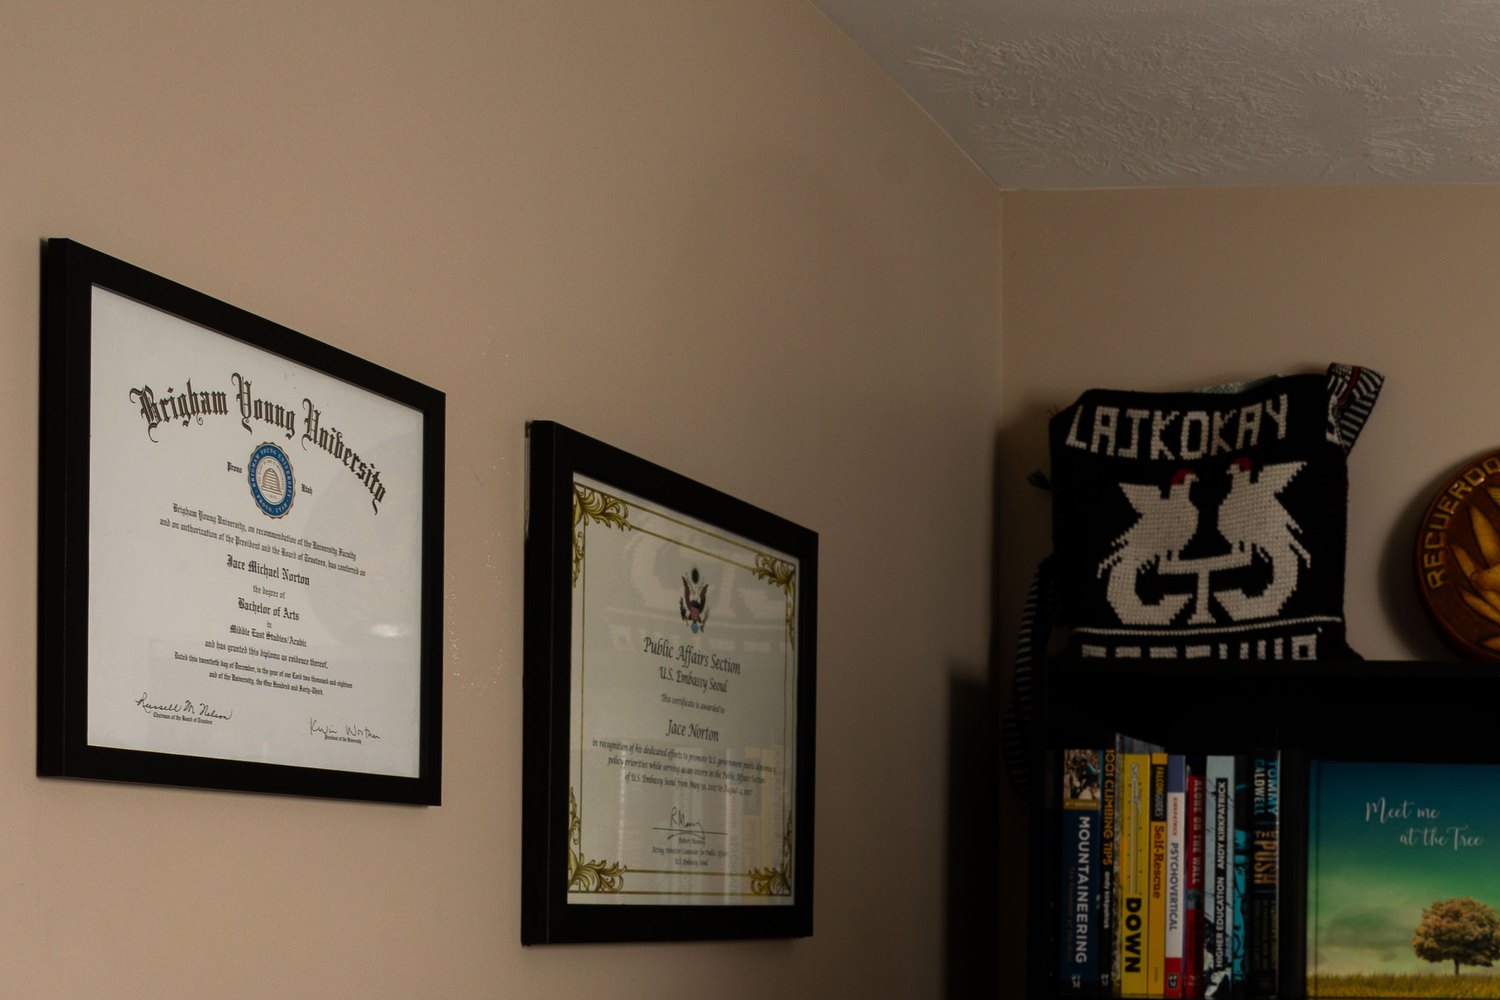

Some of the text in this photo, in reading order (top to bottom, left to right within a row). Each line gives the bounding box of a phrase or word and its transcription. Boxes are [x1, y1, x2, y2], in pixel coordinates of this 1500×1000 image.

[129, 378, 229, 443] Brigham
[231, 372, 296, 440] Young
[302, 398, 387, 515] University
[173, 503, 197, 518] Brigham
[198, 509, 217, 524] Young
[248, 525, 256, 533] on
[256, 526, 297, 545] recommendation
[304, 539, 312, 549] the
[312, 540, 338, 557] University
[338, 547, 357, 562] Faculty
[227, 554, 310, 586] Jace Michael Norton
[238, 597, 300, 621] Bachelor of Arts
[262, 586, 279, 600] degree
[229, 624, 250, 637] Middle
[251, 628, 265, 640] East
[643, 636, 741, 676] Public Affairs Section
[658, 666, 729, 694] U.S. Embassy Seoul
[665, 719, 720, 743] Jace Norton
[1104, 749, 1116, 777] 1001
[1253, 758, 1265, 816] CALDWELL
[1267, 759, 1278, 816] TOMMY
[1102, 778, 1116, 839] CLIMBING
[1365, 796, 1441, 824] Meet me
[1191, 779, 1203, 884] ALONE ON THE WALL
[1254, 830, 1276, 839] THE
[1399, 824, 1485, 851] at the Tree
[1101, 841, 1114, 866] TIPS
[1152, 825, 1165, 899] Self-Rescue
[1253, 839, 1278, 885] PUSH
[1075, 815, 1092, 965] MOUNTAINEERING
[1169, 842, 1179, 931] PSYCHOVERTICAL
[1215, 781, 1227, 968] HIGHER EDUCATION ANDY KIRKPATRICK
[1102, 890, 1112, 929] kirkpatrick
[1124, 897, 1142, 974] DOWN
